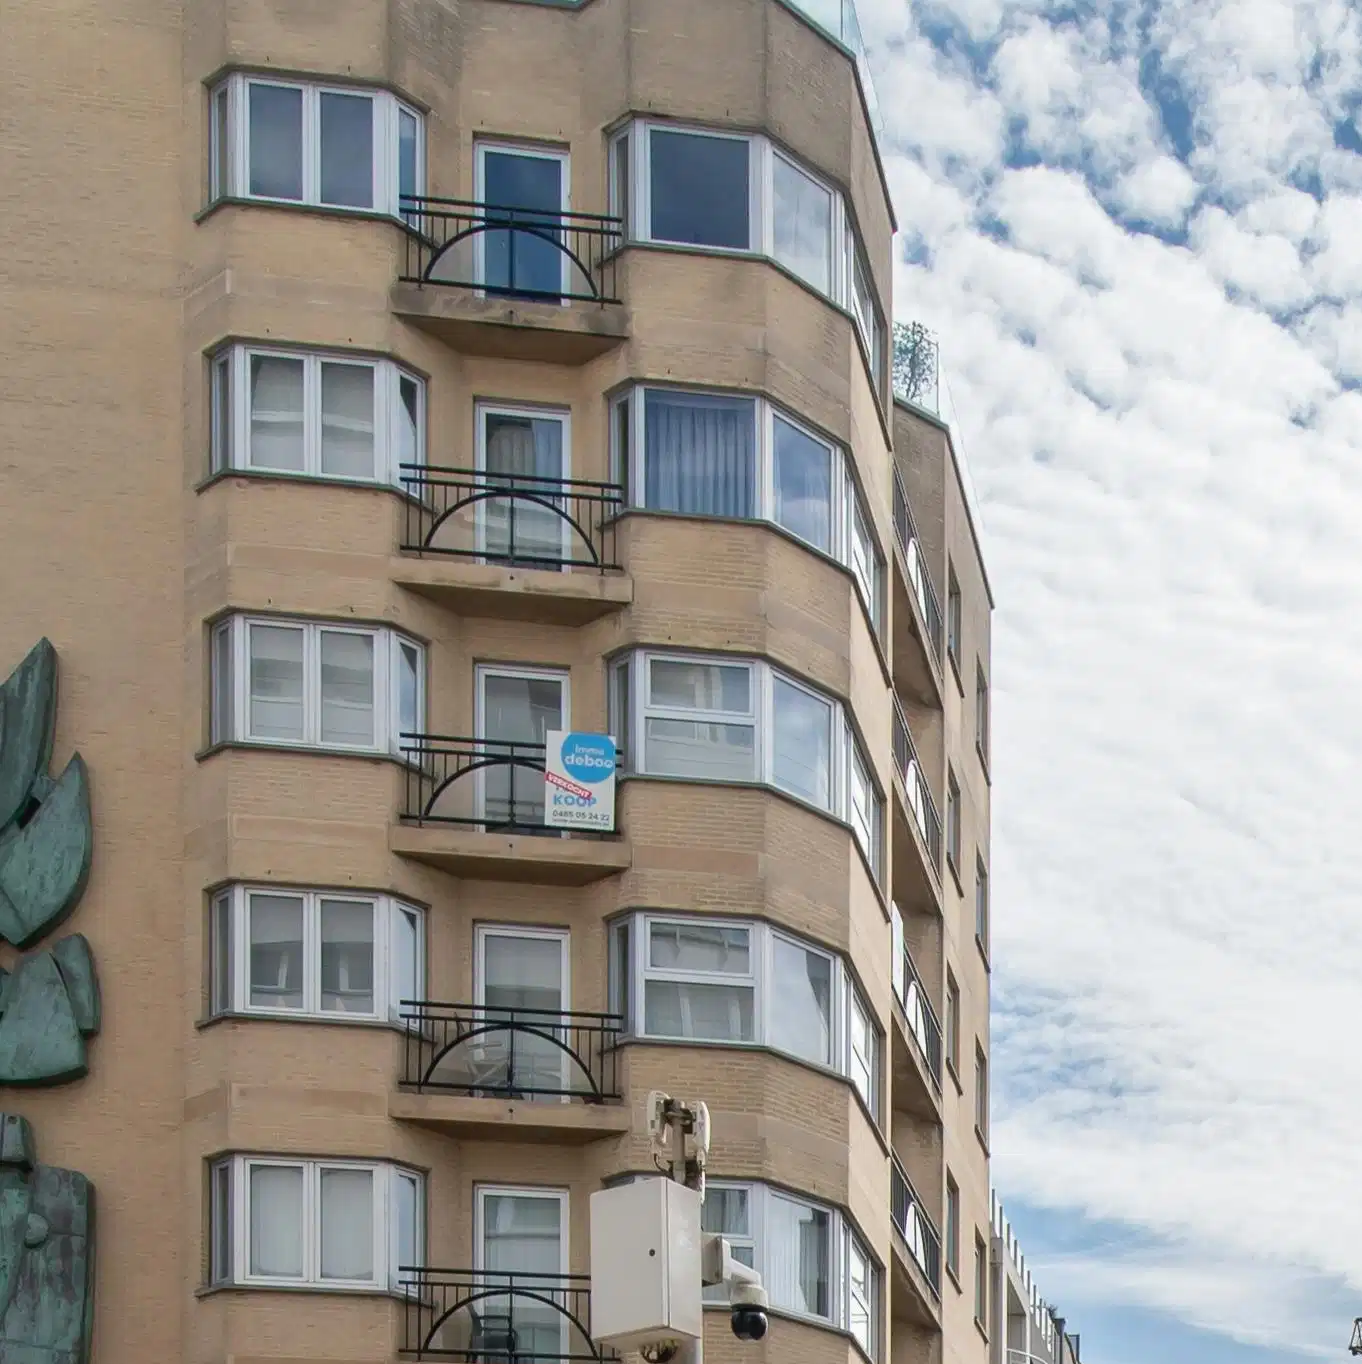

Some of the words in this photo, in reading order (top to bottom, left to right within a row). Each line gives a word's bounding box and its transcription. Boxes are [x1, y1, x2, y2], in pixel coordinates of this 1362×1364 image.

[548, 773, 591, 799] VERKOCHT
[553, 794, 597, 807] KOOP
[552, 809, 574, 818] 0485
[576, 811, 587, 819] 05
